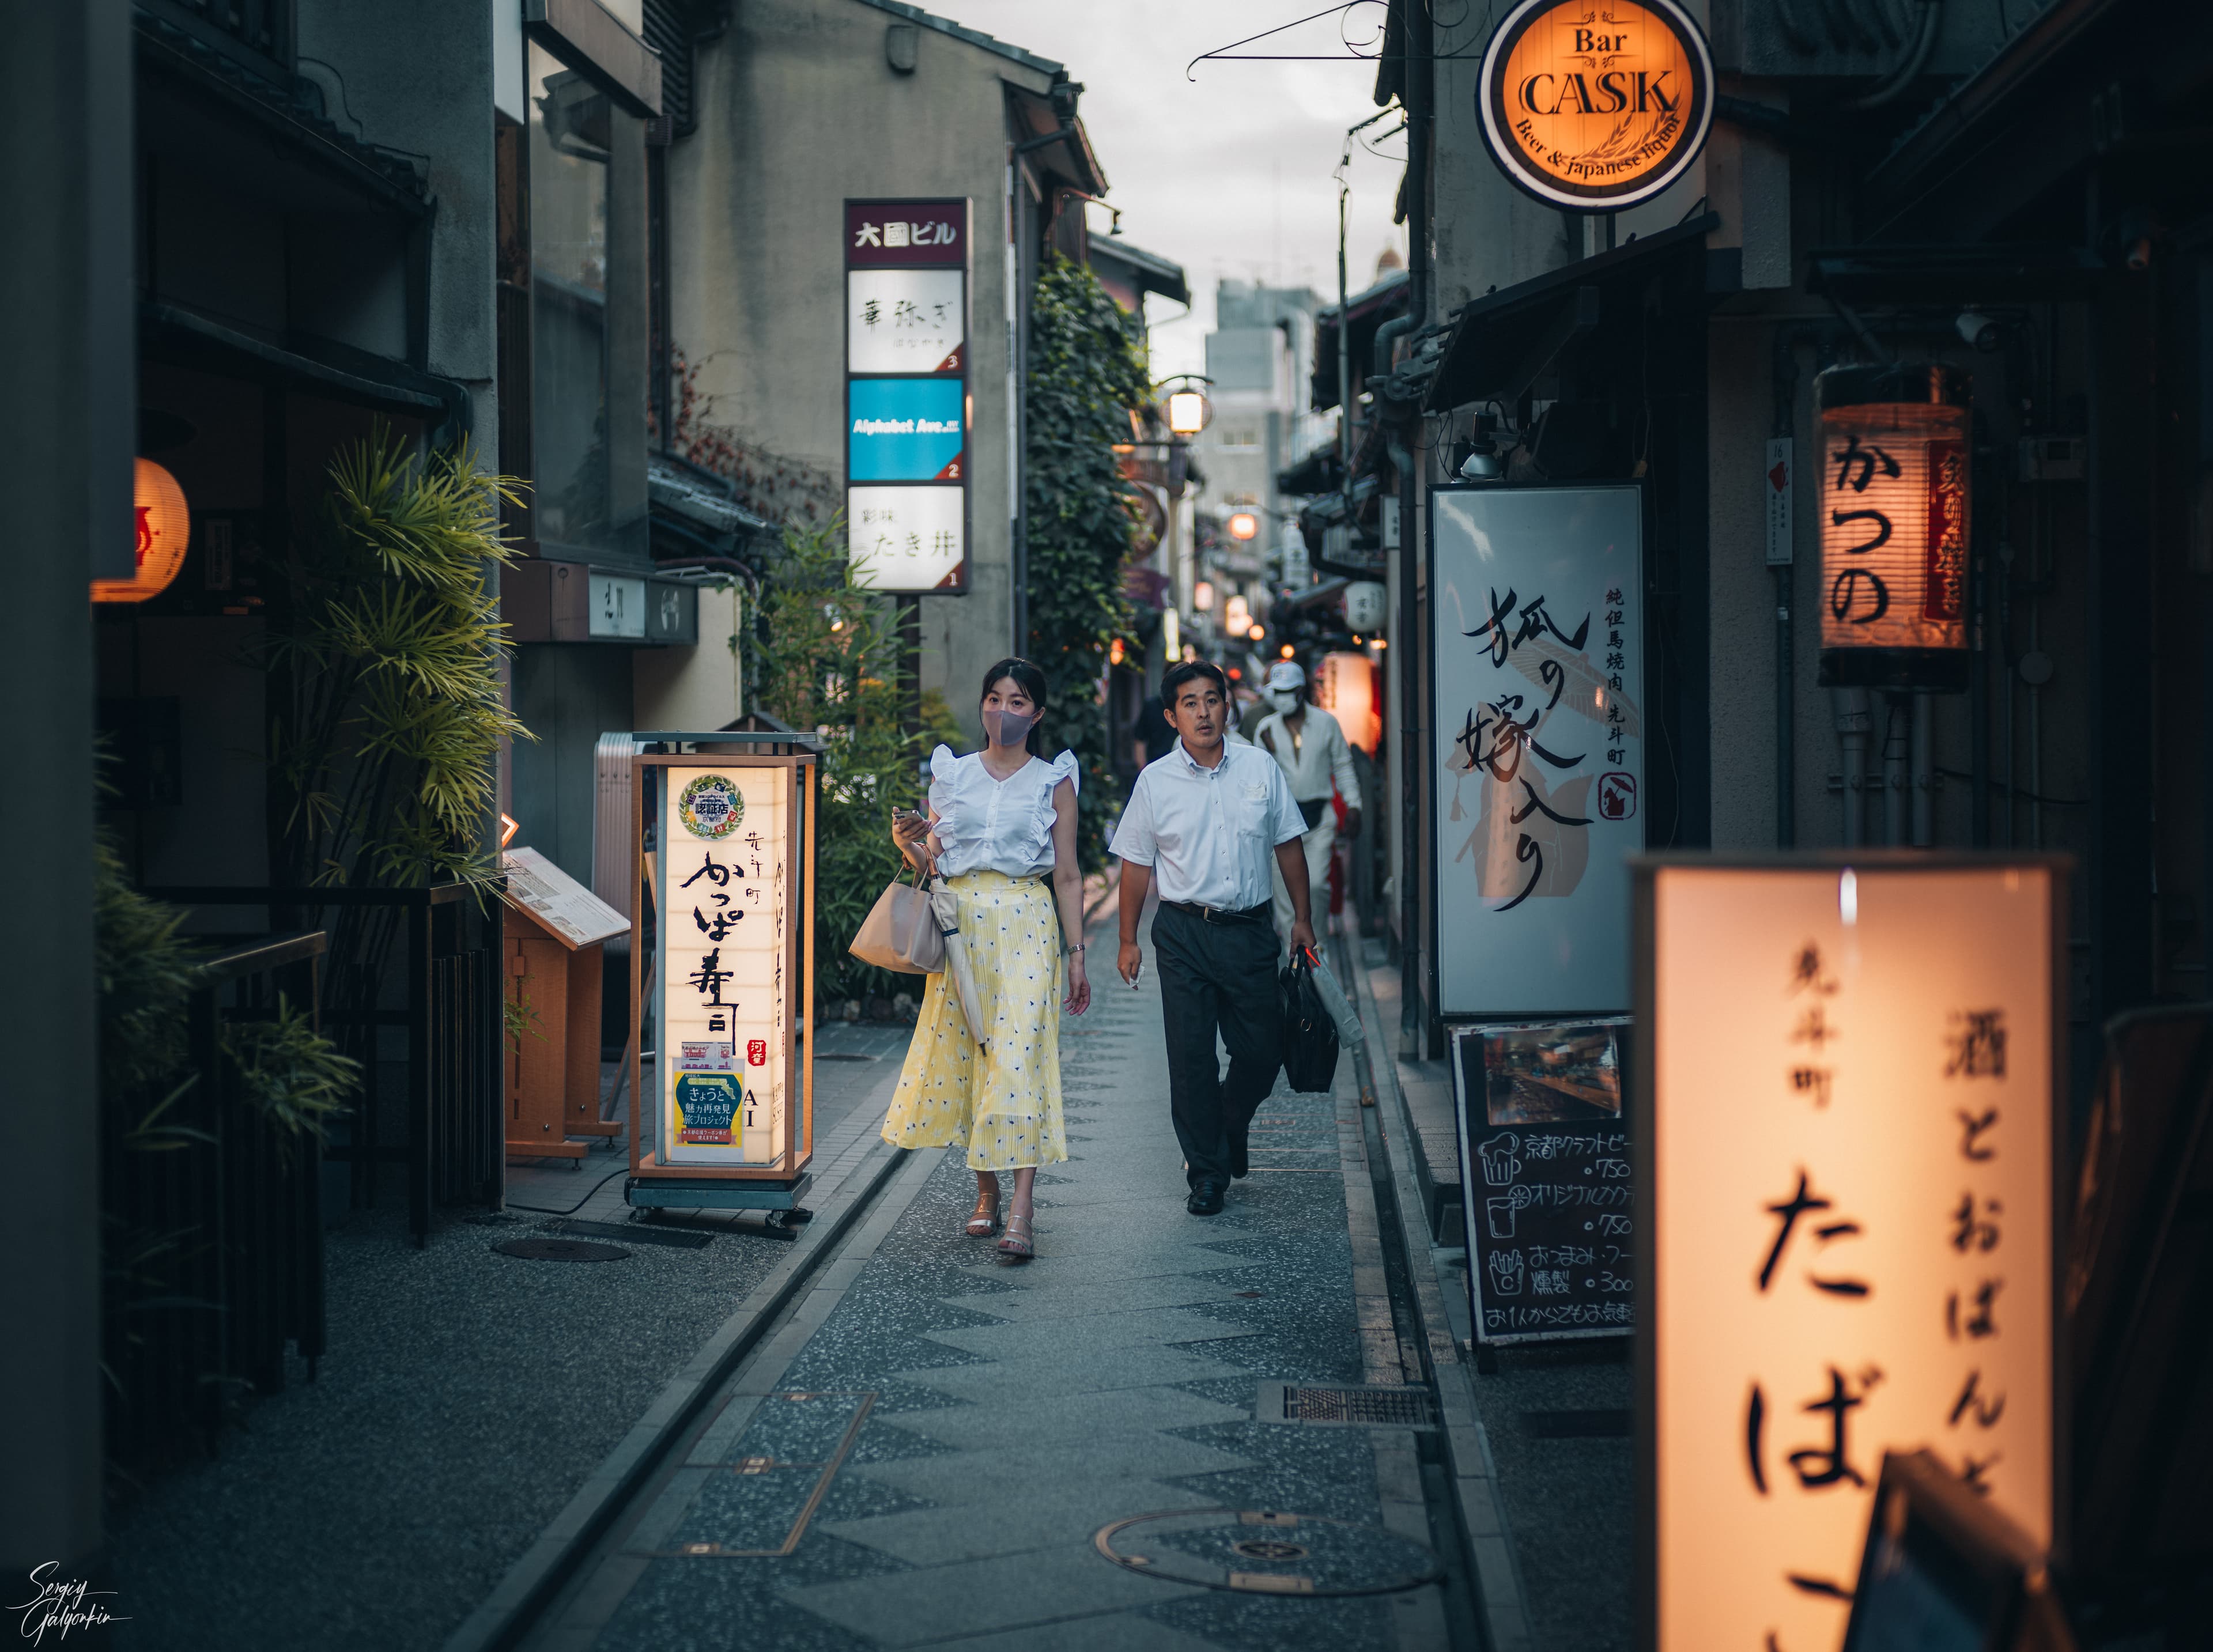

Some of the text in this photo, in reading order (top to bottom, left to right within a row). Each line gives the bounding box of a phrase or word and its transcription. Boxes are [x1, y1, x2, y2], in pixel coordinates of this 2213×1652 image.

[1574, 28, 1627, 52] Bar
[1519, 70, 1672, 115] CASK
[1516, 115, 1682, 180] Beer & japanese liquor
[947, 354, 958, 369] 3
[852, 418, 914, 436] Alphabet
[1774, 443, 1784, 459] 16
[949, 463, 959, 479] 2
[1831, 434, 1901, 625] かつの
[875, 530, 956, 558] たき井
[949, 572, 958, 586] 1
[1605, 588, 1626, 766] 純但馬焼肉 先斗町
[1456, 586, 1595, 912] 狐の嫁入り
[695, 803, 728, 814] 認証店
[745, 830, 765, 905] 先斗町
[679, 850, 745, 1056] かっぱ寿司
[750, 1041, 765, 1065] 河童
[689, 1087, 725, 1102] きょうと
[685, 1102, 731, 1114] 魅力再発見
[683, 1114, 732, 1125] 旅プロジェクト
[1595, 1158, 1631, 1178] 750
[1598, 1214, 1633, 1237] 750
[1600, 1271, 1634, 1292] 300
